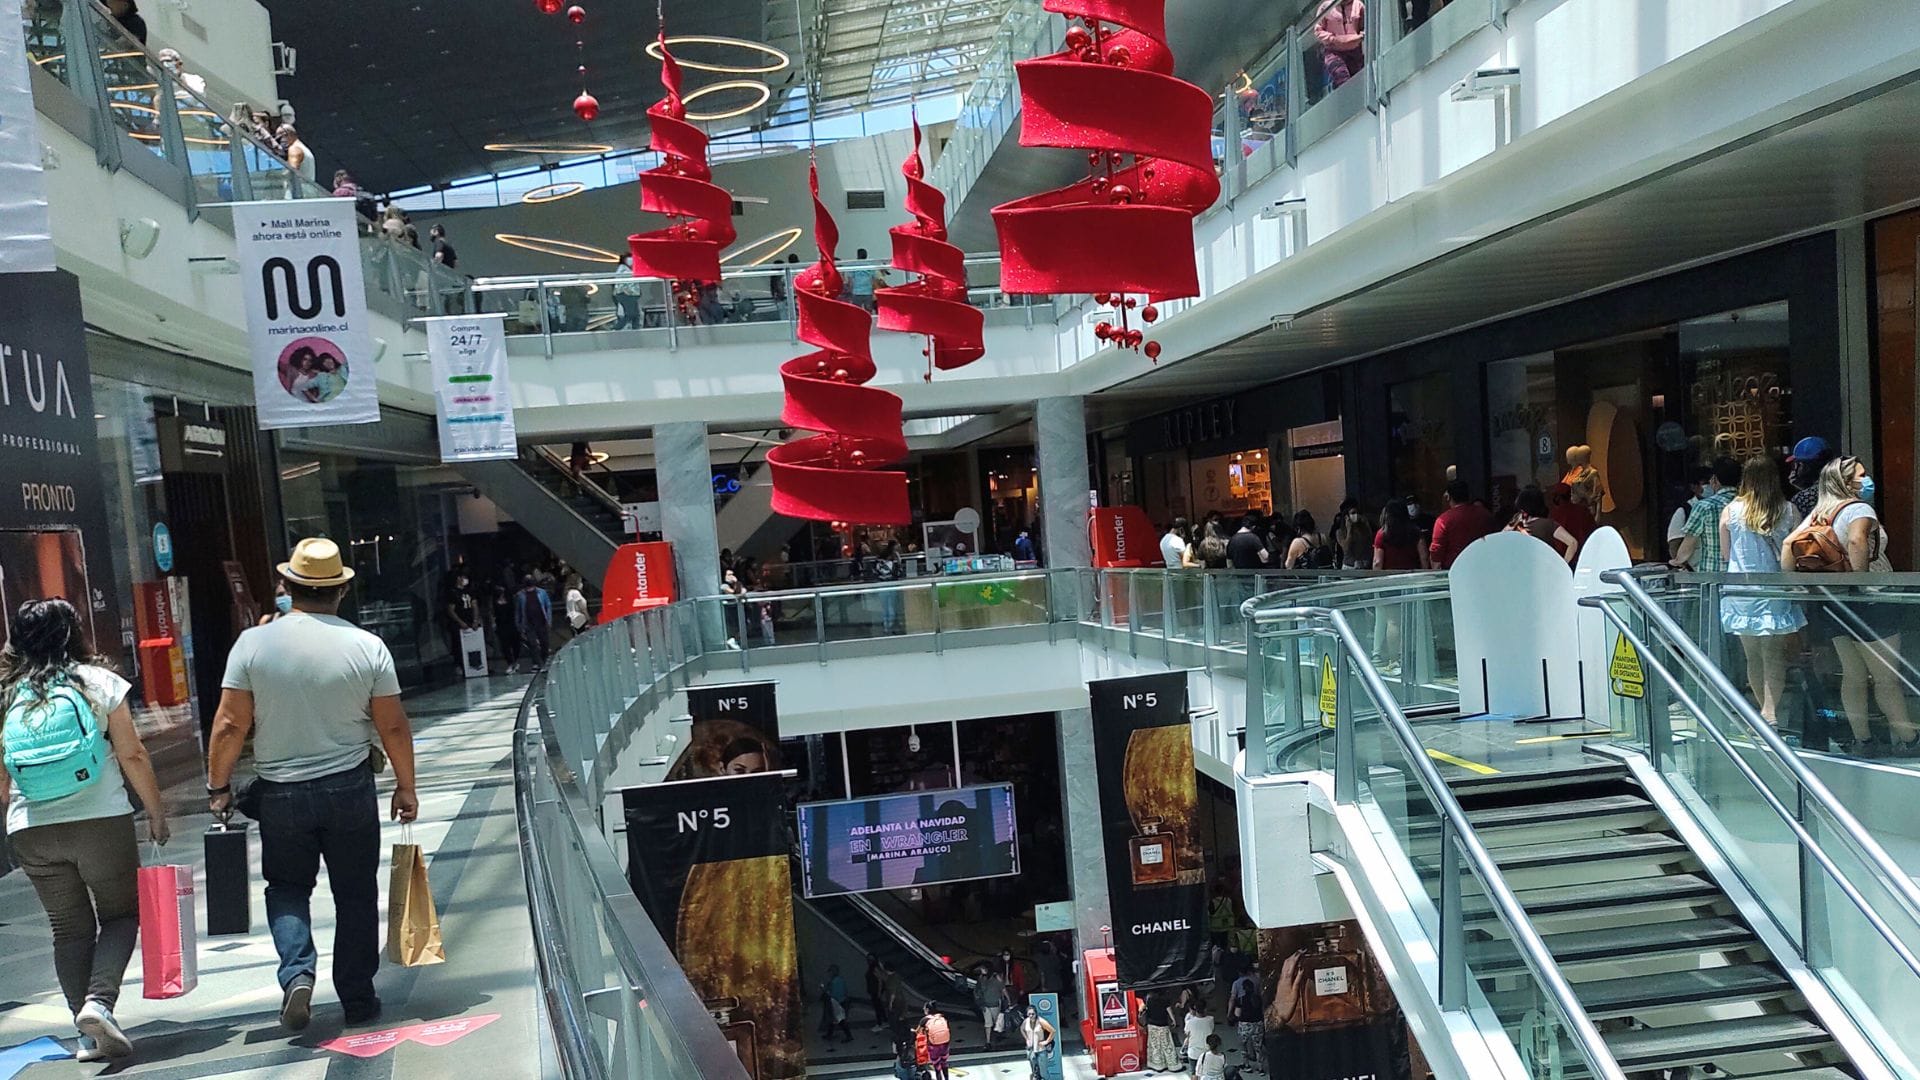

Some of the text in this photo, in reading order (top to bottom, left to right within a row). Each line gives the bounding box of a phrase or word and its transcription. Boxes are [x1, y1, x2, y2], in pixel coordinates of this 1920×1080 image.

[271, 218, 330, 228] Mall Marina
[252, 229, 342, 241] ahora está online
[268, 322, 349, 335] marinaonline.cl
[450, 334, 482, 346] 24/7
[1163, 400, 1238, 447] RIPLEY
[2, 433, 82, 456] PROFESSIONAL
[22, 482, 76, 512] PRONTO
[1113, 514, 1126, 562] ntander
[634, 551, 648, 600] ntander
[850, 815, 966, 836] ADELANTA LA NAVIDAD
[850, 828, 969, 854] EN WRANGLER
[866, 845, 951, 863] [MARINA ARAUCO]
[1131, 918, 1191, 935] CHANEL
